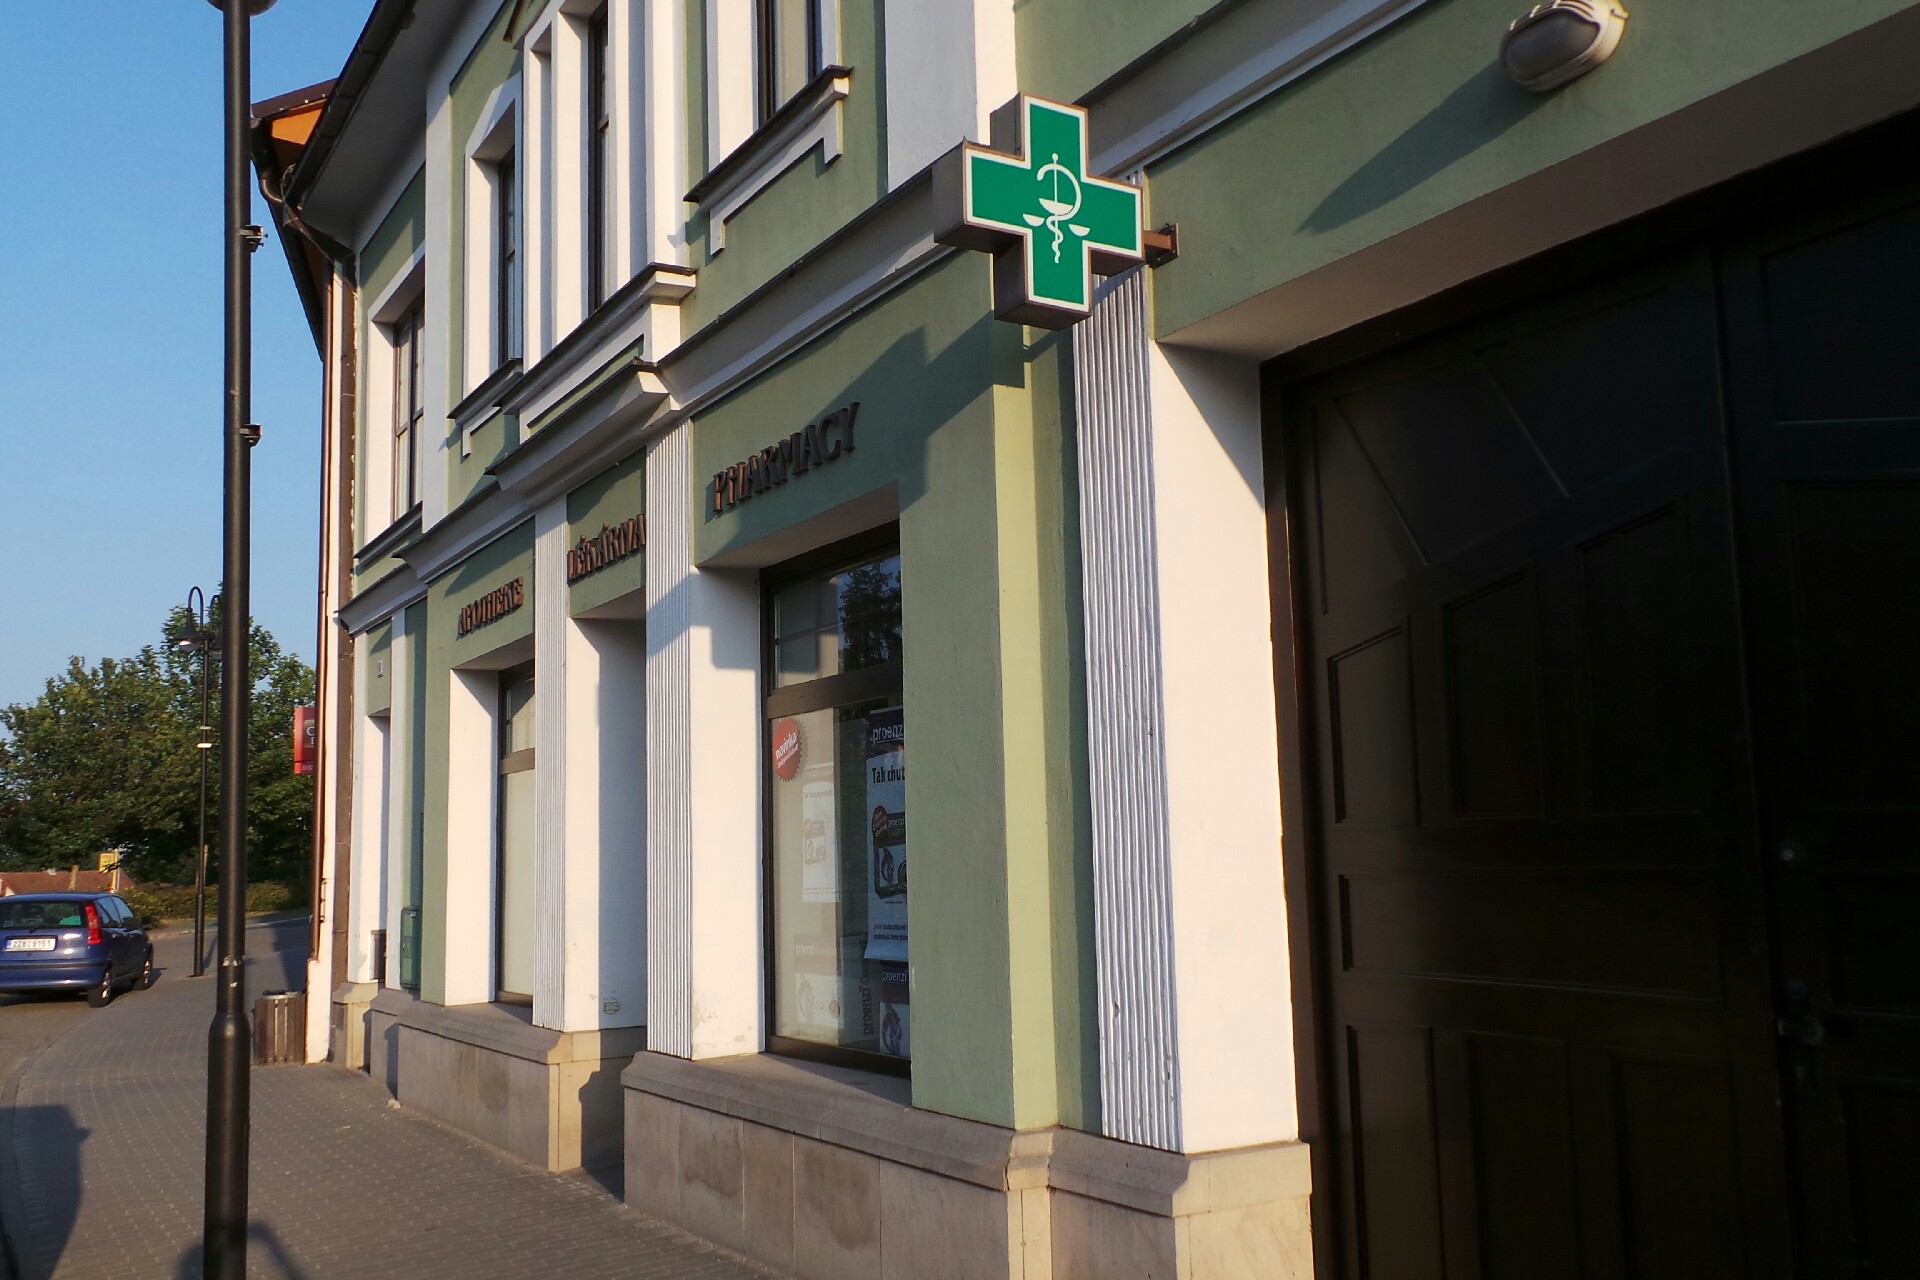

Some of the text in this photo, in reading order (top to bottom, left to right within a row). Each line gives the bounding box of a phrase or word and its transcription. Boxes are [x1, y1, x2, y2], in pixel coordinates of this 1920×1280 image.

[713, 402, 861, 513] PHARMACY
[873, 724, 904, 746] proenz
[872, 766, 886, 784] Tak
